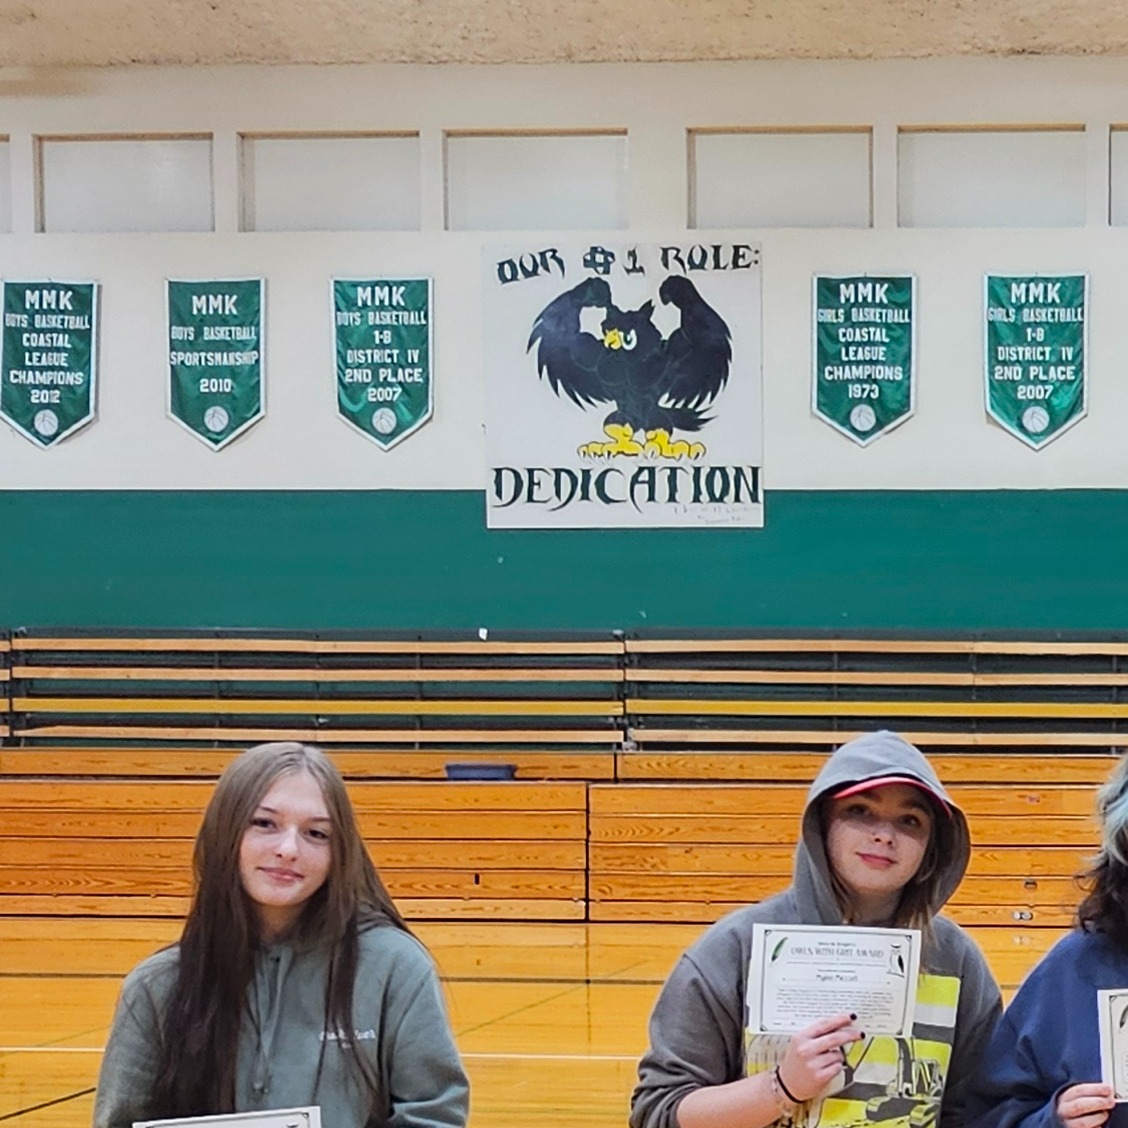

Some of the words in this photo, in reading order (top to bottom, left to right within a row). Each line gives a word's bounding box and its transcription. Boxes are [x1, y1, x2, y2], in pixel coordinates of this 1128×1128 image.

[26, 290, 72, 310] MMK
[357, 286, 405, 306] MMK
[840, 283, 888, 303] MMK
[1012, 283, 1060, 303] MMK
[192, 295, 237, 314] MMK
[6, 313, 28, 327] BOYS
[35, 315, 90, 329] BASKETBALL
[337, 312, 361, 325] BOYS
[368, 311, 426, 325] BASKETBALL
[818, 308, 844, 323] GIRLS
[852, 308, 909, 323] BASKETBALL
[988, 307, 1015, 322] GIRLS
[1023, 307, 1084, 321] BASKETBALL
[23, 333, 71, 348] COASTAL
[171, 326, 194, 340] BOYS
[204, 327, 256, 340] BASKETBALL
[374, 330, 391, 344] 1-B
[839, 327, 889, 342] COASTAL
[1027, 328, 1044, 341] 1-B
[25, 352, 68, 366] LEAGUE
[170, 351, 258, 366] SPORTSMANSHIP
[347, 349, 399, 363] DISTRICT
[408, 350, 419, 363] IV
[842, 347, 886, 360] LEAGUE
[998, 347, 1051, 361] DISTRICT
[1061, 347, 1073, 360] IV
[10, 370, 83, 385] CHAMPIONS
[345, 369, 371, 382] 2ND
[379, 368, 423, 382] PLACE
[825, 365, 902, 380] CHAMPIONS
[995, 366, 1022, 380] 2ND
[1030, 366, 1075, 381] PLACE
[200, 379, 232, 392] 2010
[849, 384, 878, 398] 1973
[1017, 385, 1053, 399] 2007
[31, 390, 60, 403] 2012
[368, 387, 401, 401] 2007
[491, 466, 761, 513] DEDICATION
